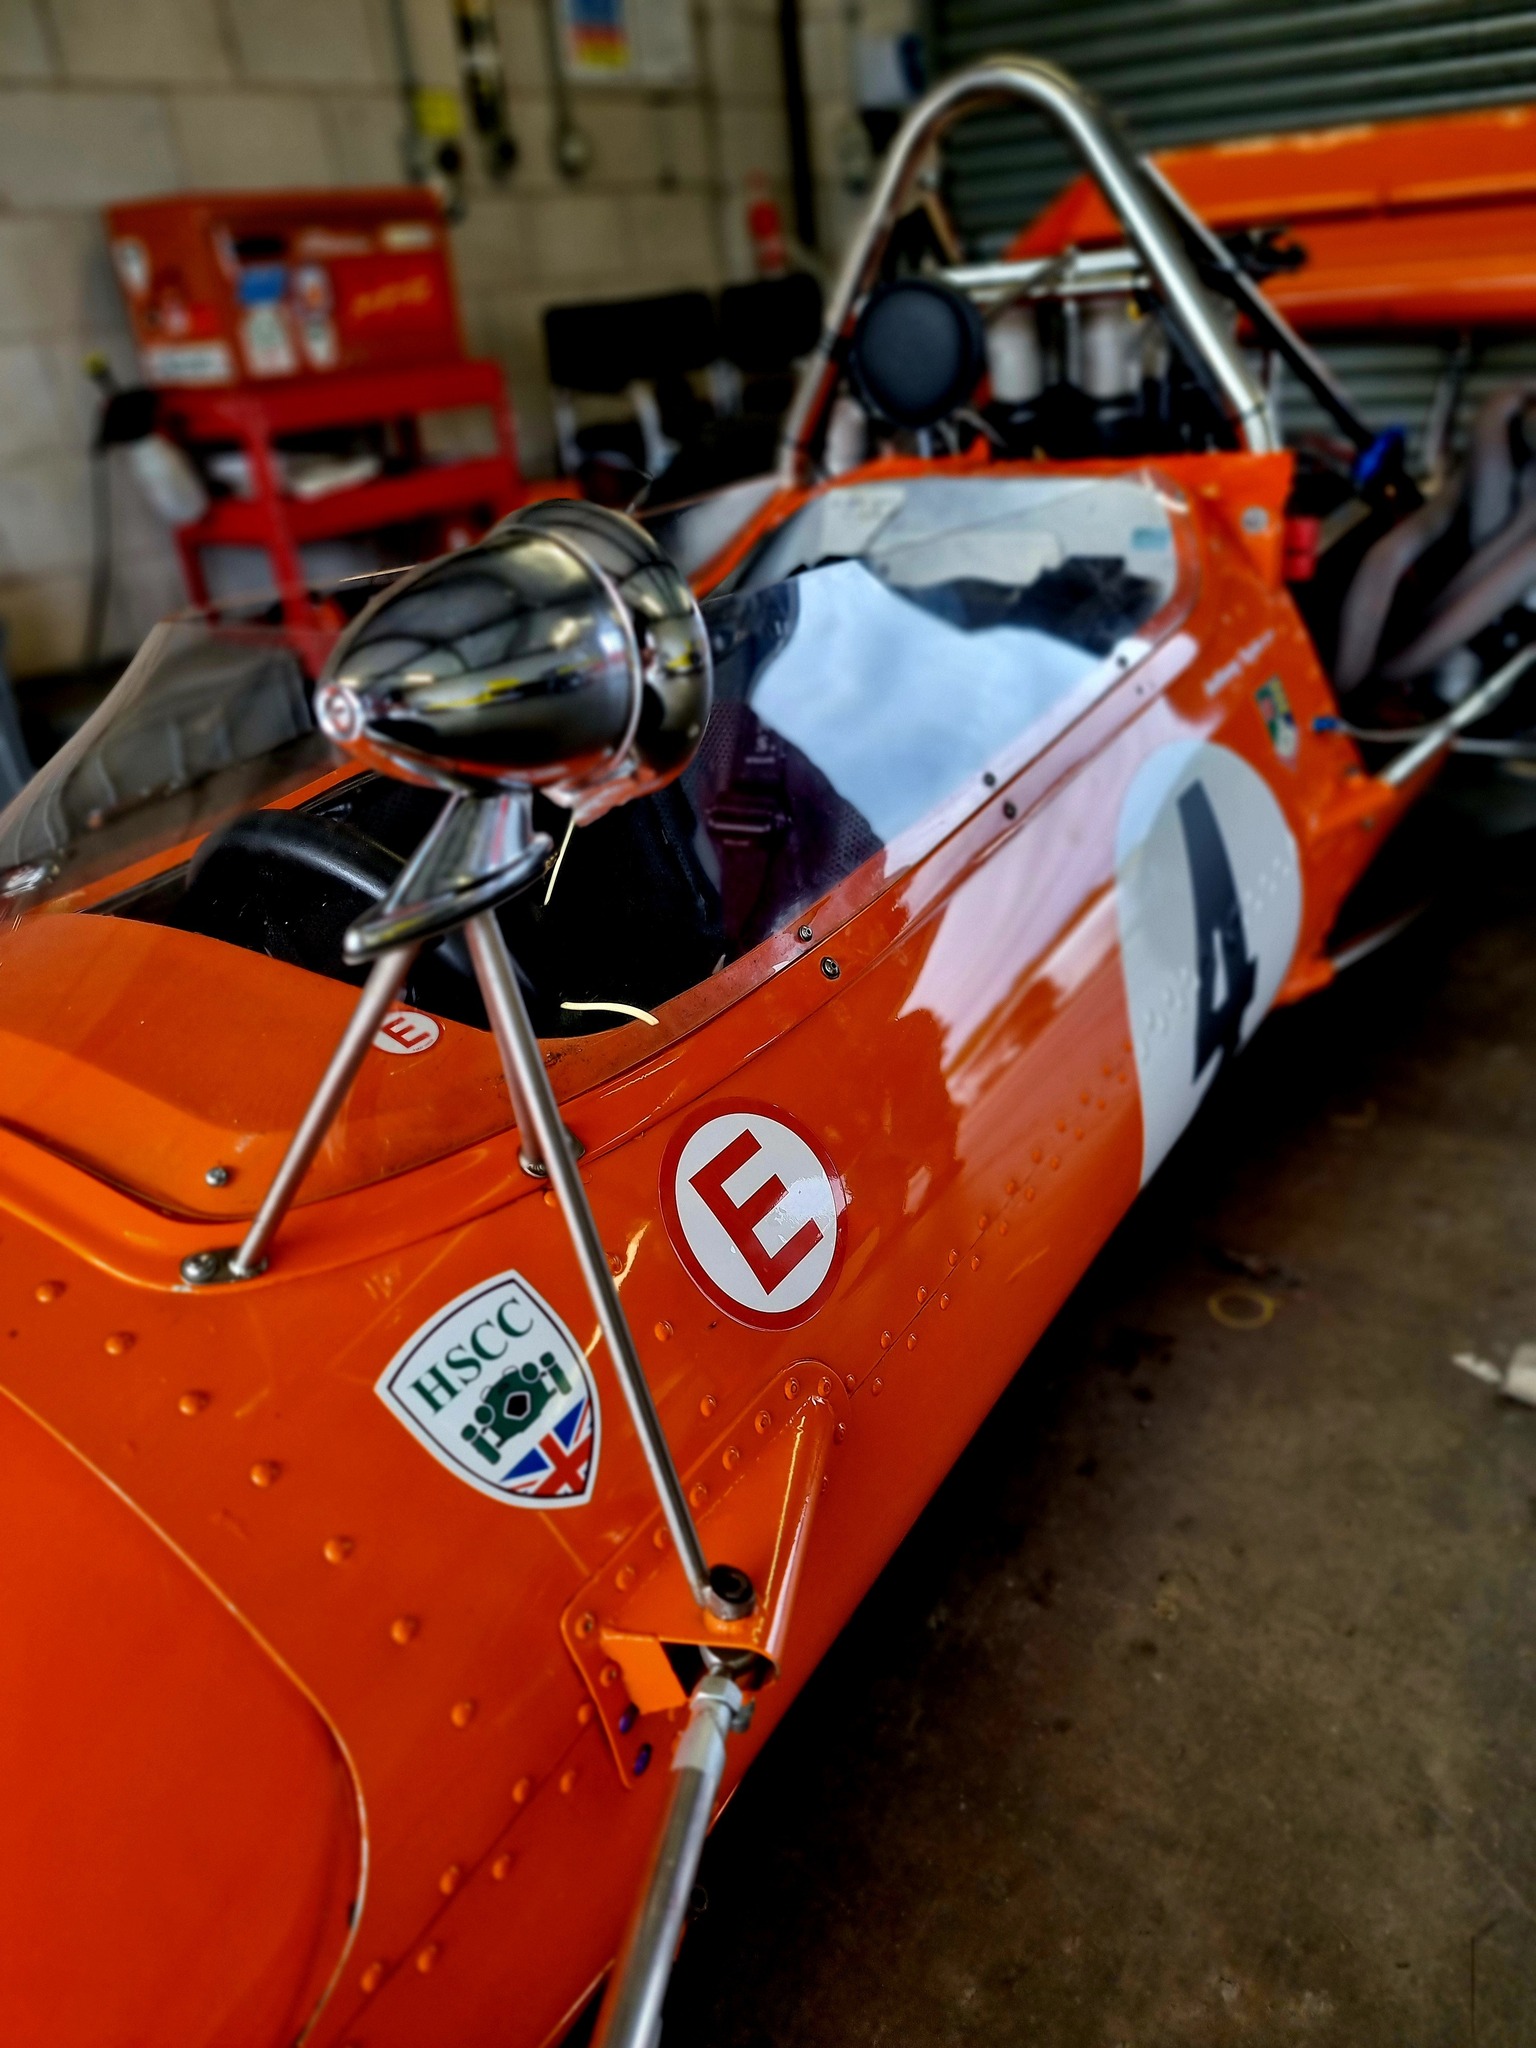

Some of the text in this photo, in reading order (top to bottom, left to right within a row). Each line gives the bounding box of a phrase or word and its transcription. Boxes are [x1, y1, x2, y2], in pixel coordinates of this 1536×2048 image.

[1177, 779, 1258, 1085] 4
[382, 1017, 430, 1049] E
[688, 1128, 824, 1296] E
[409, 1296, 534, 1415] HSCC
